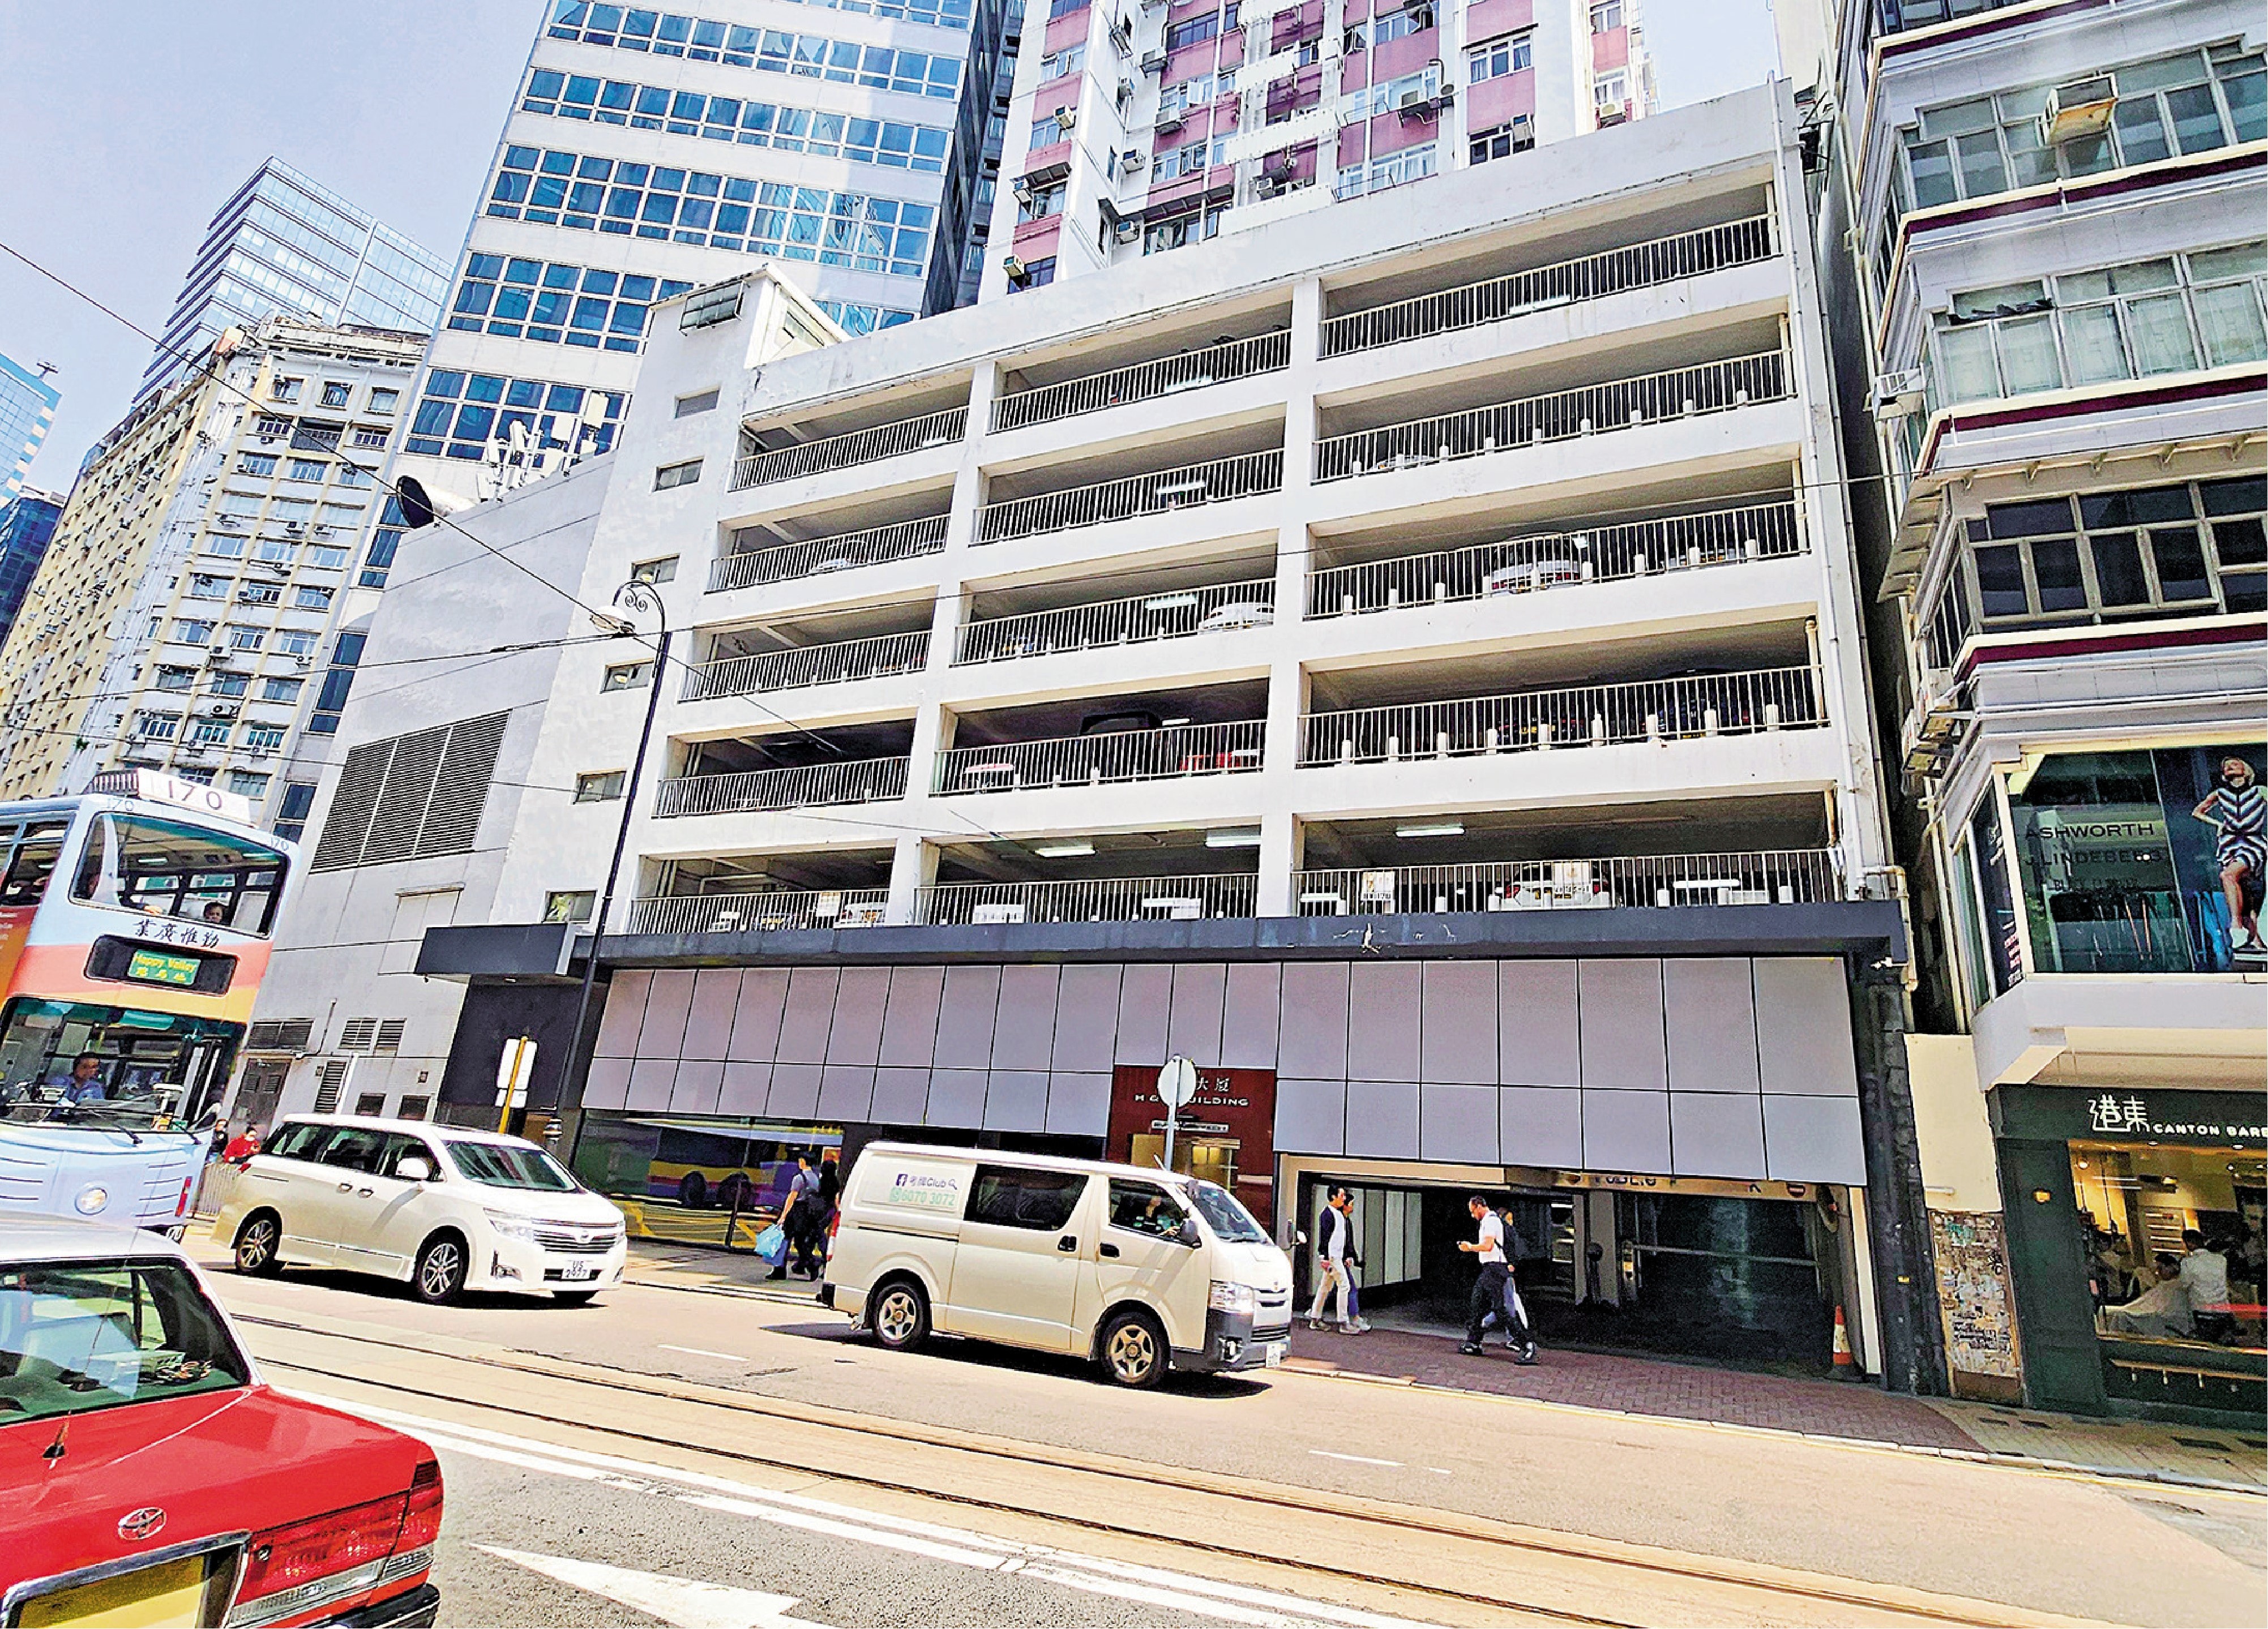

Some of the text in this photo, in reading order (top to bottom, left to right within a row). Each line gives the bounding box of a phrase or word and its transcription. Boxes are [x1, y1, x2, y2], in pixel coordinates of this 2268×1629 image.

[169, 781, 222, 811] 170
[106, 799, 134, 812] 170
[2025, 823, 2154, 839] ASHWORTH
[271, 837, 290, 851] 170
[135, 954, 164, 968] Happy
[1189, 1096, 1249, 1106] UILDING
[2153, 1124, 2220, 1135] CANTON
